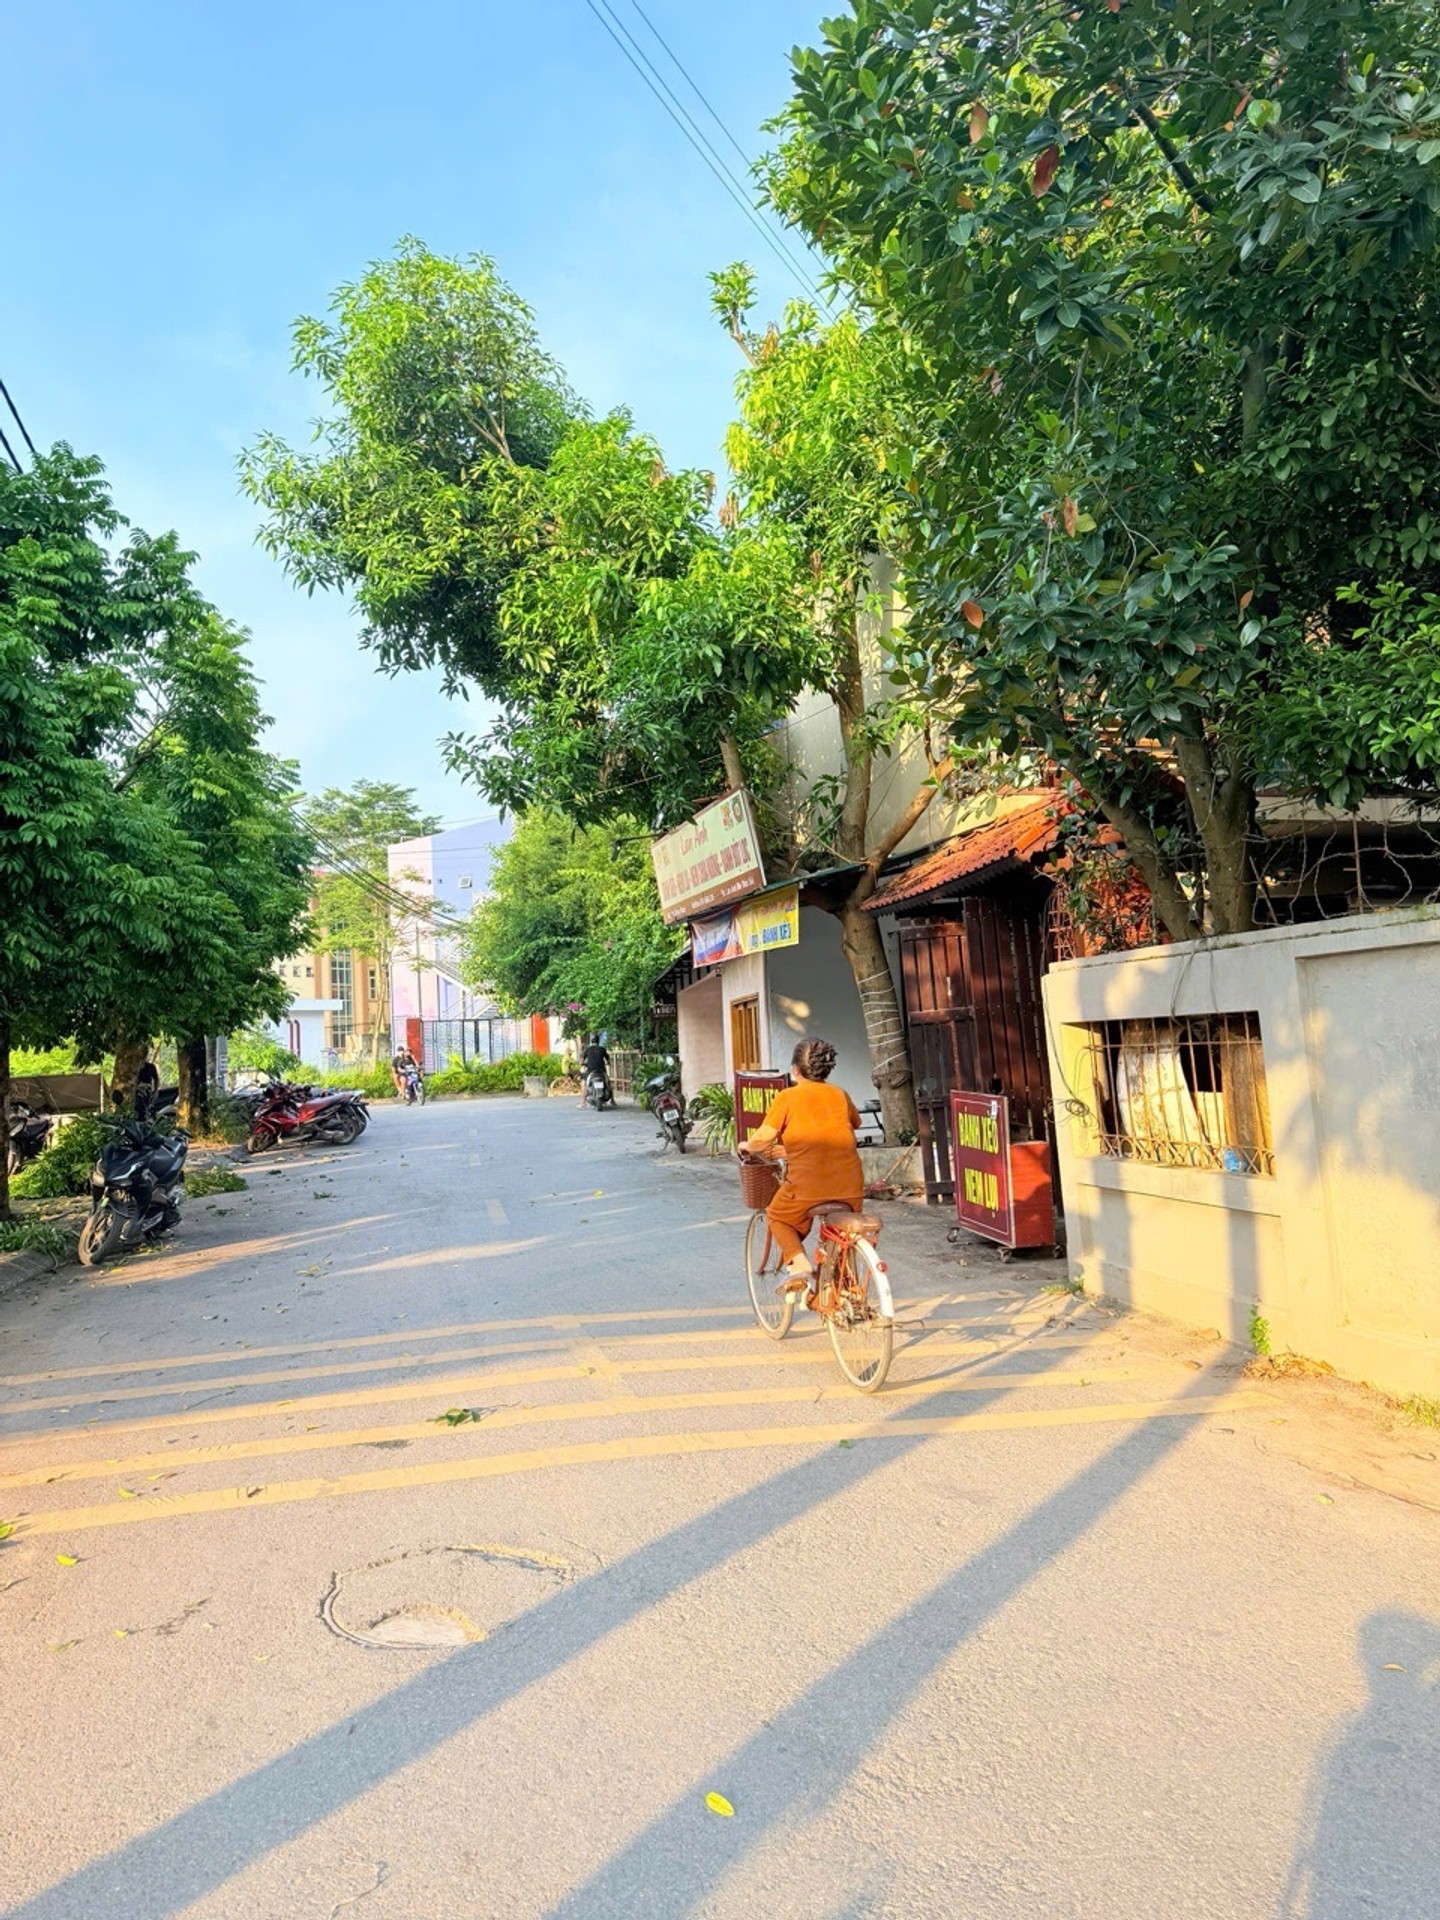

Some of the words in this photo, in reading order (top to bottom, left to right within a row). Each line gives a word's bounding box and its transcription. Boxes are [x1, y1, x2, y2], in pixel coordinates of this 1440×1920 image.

[742, 1081, 764, 1114] BÁNH
[764, 1083, 779, 1113] XÈ
[958, 1106, 981, 1150] BÁNH
[981, 1110, 999, 1154] XÈO
[964, 1167, 984, 1206] NEM
[984, 1172, 999, 1218] LỤI
